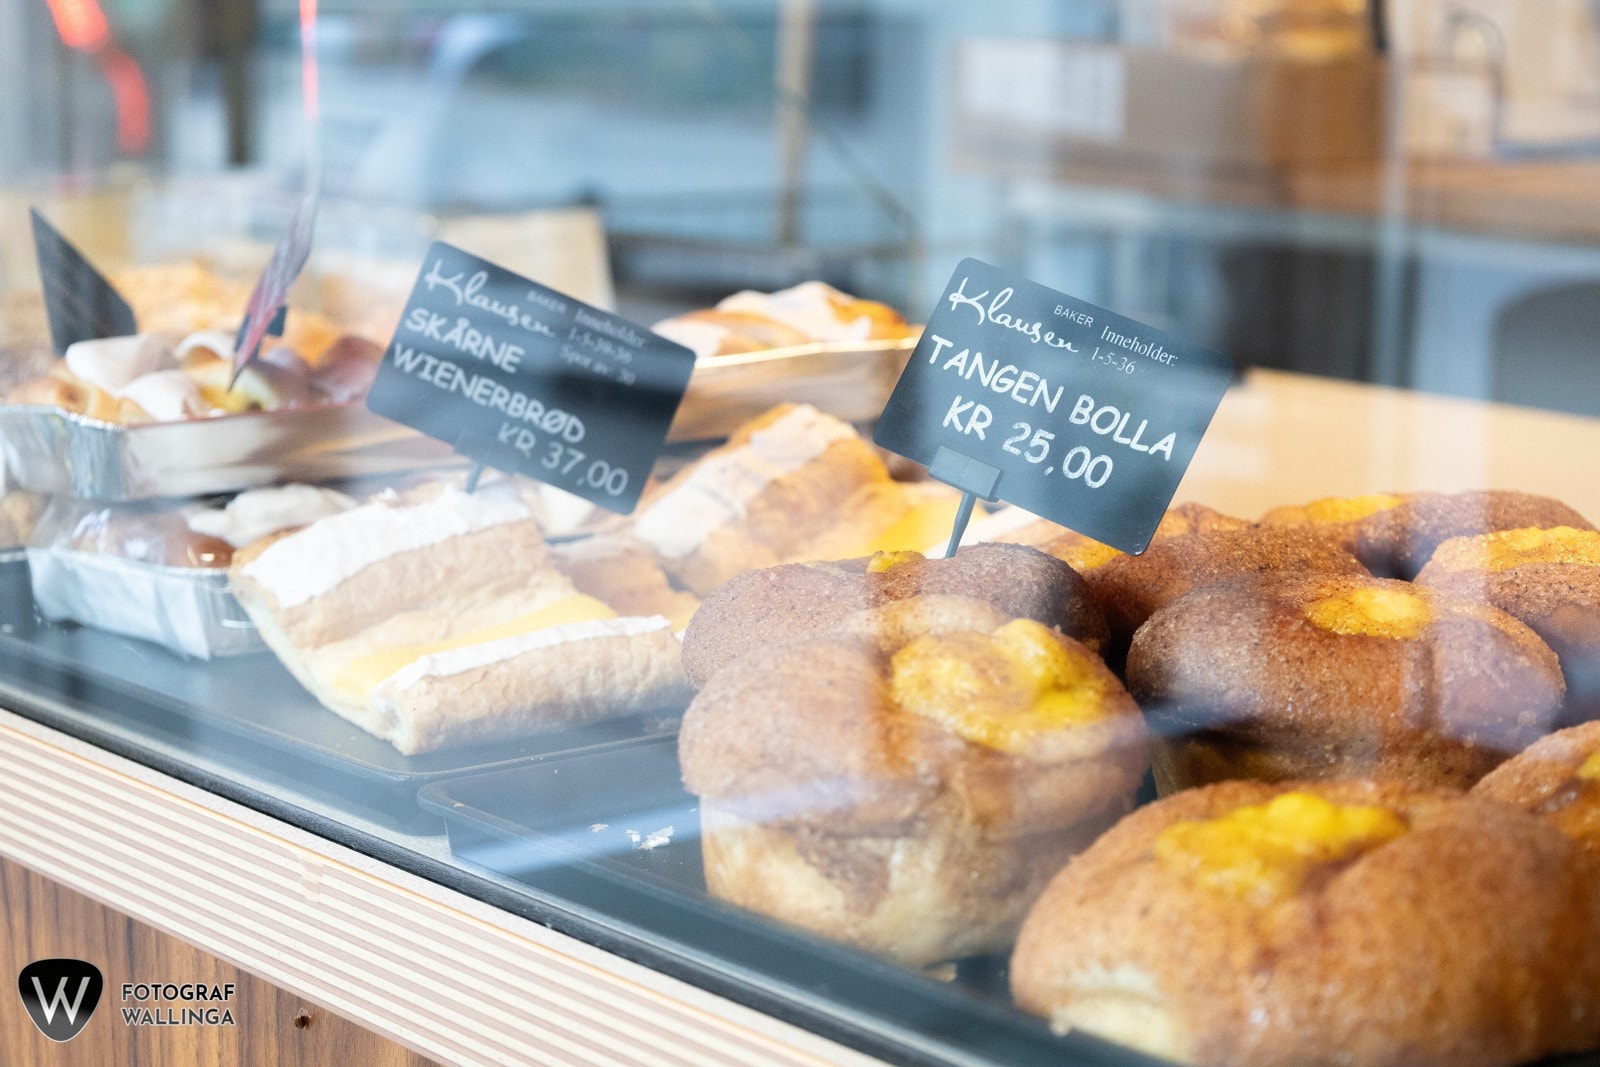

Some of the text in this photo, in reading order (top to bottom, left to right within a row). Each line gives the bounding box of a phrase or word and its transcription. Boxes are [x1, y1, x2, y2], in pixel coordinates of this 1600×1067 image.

[424, 258, 556, 338] Klausen
[948, 276, 1079, 354] Klausen
[1053, 303, 1095, 328] BAKER
[404, 307, 527, 375] SKÅRNE
[1090, 346, 1137, 375] 1-5-36
[1099, 324, 1179, 367] Inneholder:
[393, 342, 586, 444] WIENERBRØD
[928, 333, 1177, 462] TANGEN BOLLA
[498, 421, 630, 497] KR 37,00
[942, 394, 1114, 489] KR 25,00
